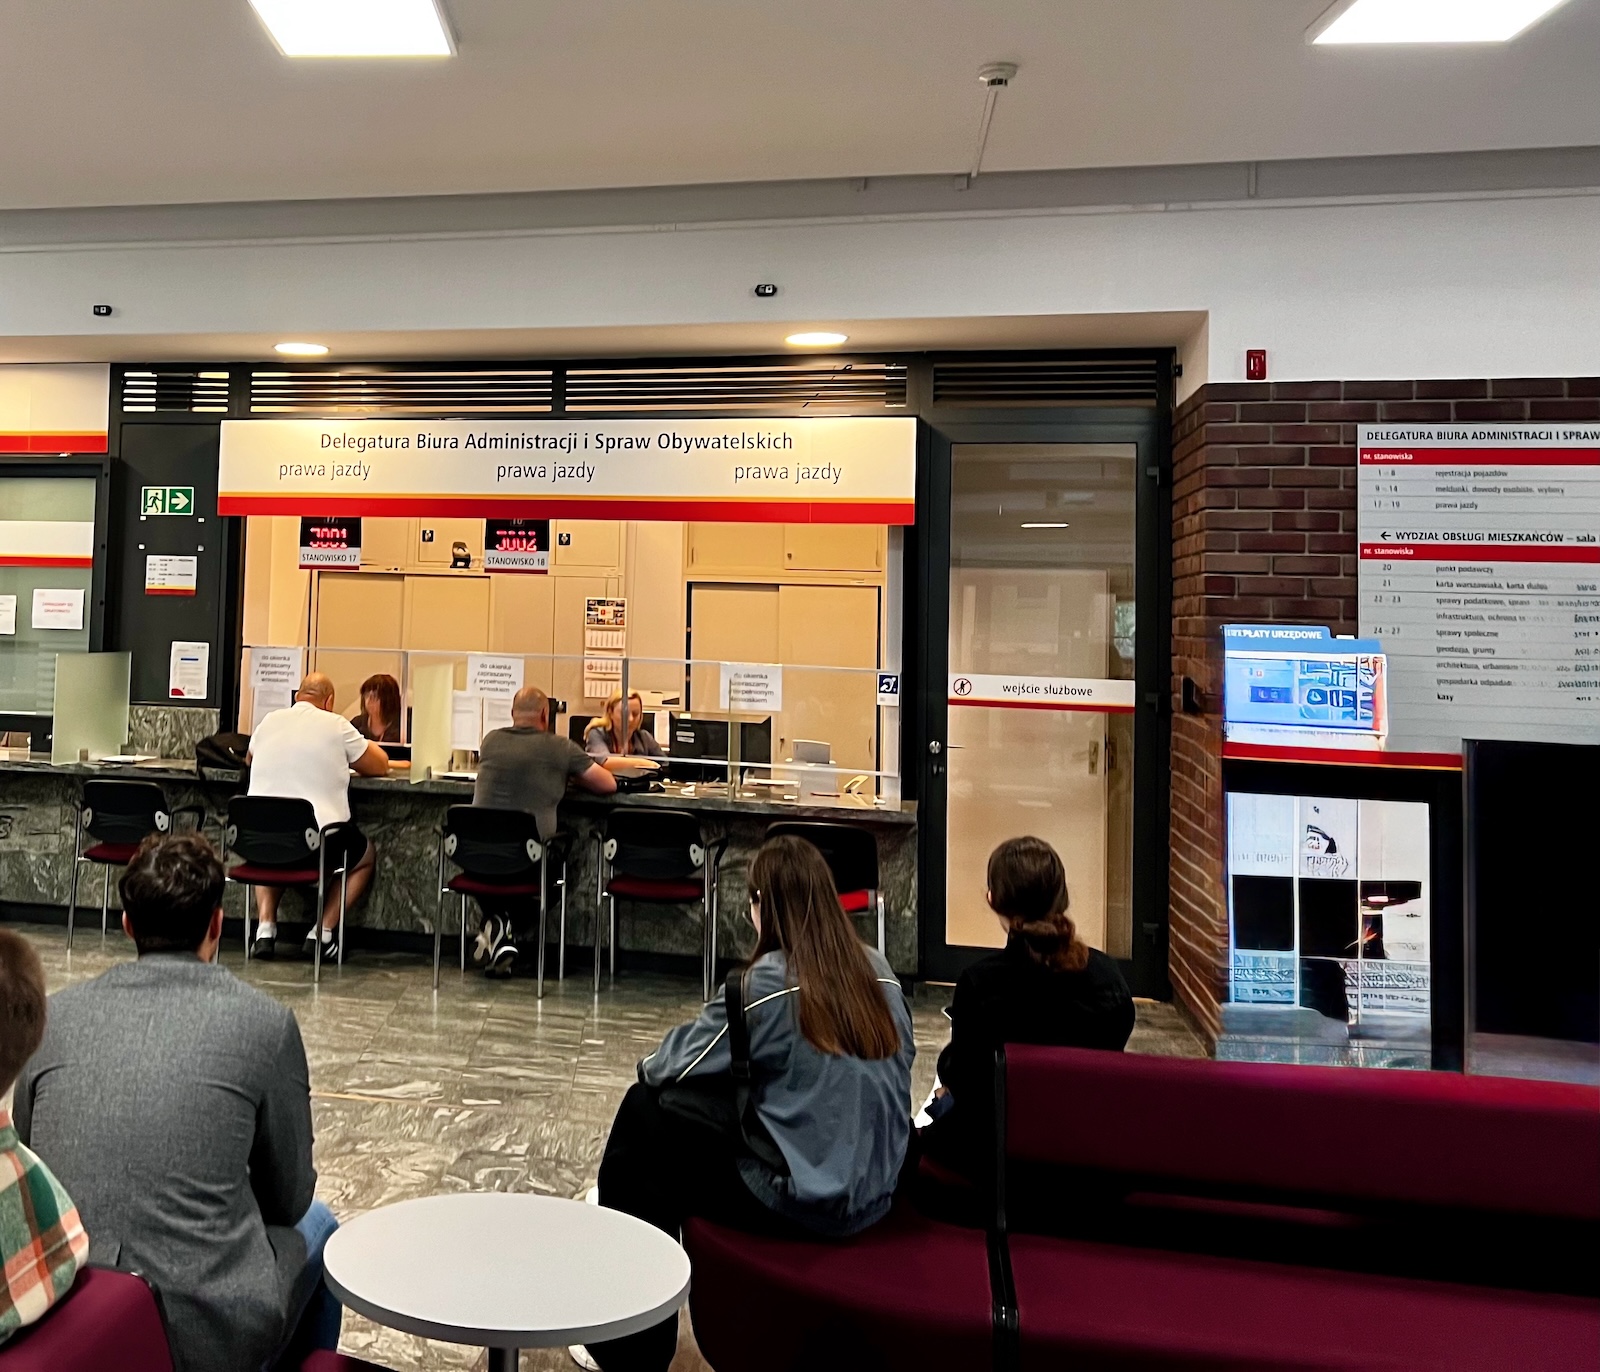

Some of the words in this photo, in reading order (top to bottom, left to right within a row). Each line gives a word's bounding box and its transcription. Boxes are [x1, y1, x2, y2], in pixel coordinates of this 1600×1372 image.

[1366, 431, 1434, 441] DELEGATURA
[1437, 431, 1469, 441] BIURA
[1471, 431, 1553, 440] ADMINISTRACJI
[1556, 431, 1560, 440] I
[1563, 431, 1600, 440] SPRAW
[321, 433, 410, 453] Delegatura
[417, 433, 459, 449] Biura
[465, 432, 577, 454] Administracji
[583, 433, 588, 449] i
[595, 433, 651, 453] Spraw
[658, 432, 793, 454] Obywatelskich
[1374, 452, 1413, 460] stanowiska
[279, 463, 325, 480] prawa
[331, 461, 371, 480] jazdy
[497, 464, 546, 482] prawa
[552, 461, 596, 482] jazdy
[735, 466, 789, 484] prawa
[795, 462, 842, 484] jazdy
[1435, 470, 1471, 478] rejestracja
[1473, 470, 1508, 478] pojazdów
[1472, 486, 1501, 494] dowody
[1435, 502, 1458, 510] prawa
[1459, 501, 1478, 510] jazdy
[1395, 531, 1439, 541] WYDZIAŁ
[1442, 532, 1485, 541] OBSŁUGI
[1488, 530, 1564, 542] MIESZKAŃCÓW
[1576, 534, 1596, 542] sala
[1374, 547, 1414, 555] stanowiska
[302, 554, 347, 562] STANOWISKO
[349, 554, 357, 562] 17
[487, 557, 535, 566] STANOWISKO
[537, 557, 545, 566] 18
[1382, 579, 1391, 587] 21
[1435, 580, 1454, 588] karta
[1506, 581, 1525, 589] karta
[1271, 630, 1323, 640] URZĘDOWE
[1472, 647, 1495, 655] grunty
[1002, 683, 1040, 696] wejście
[1043, 683, 1093, 697] służbowe
